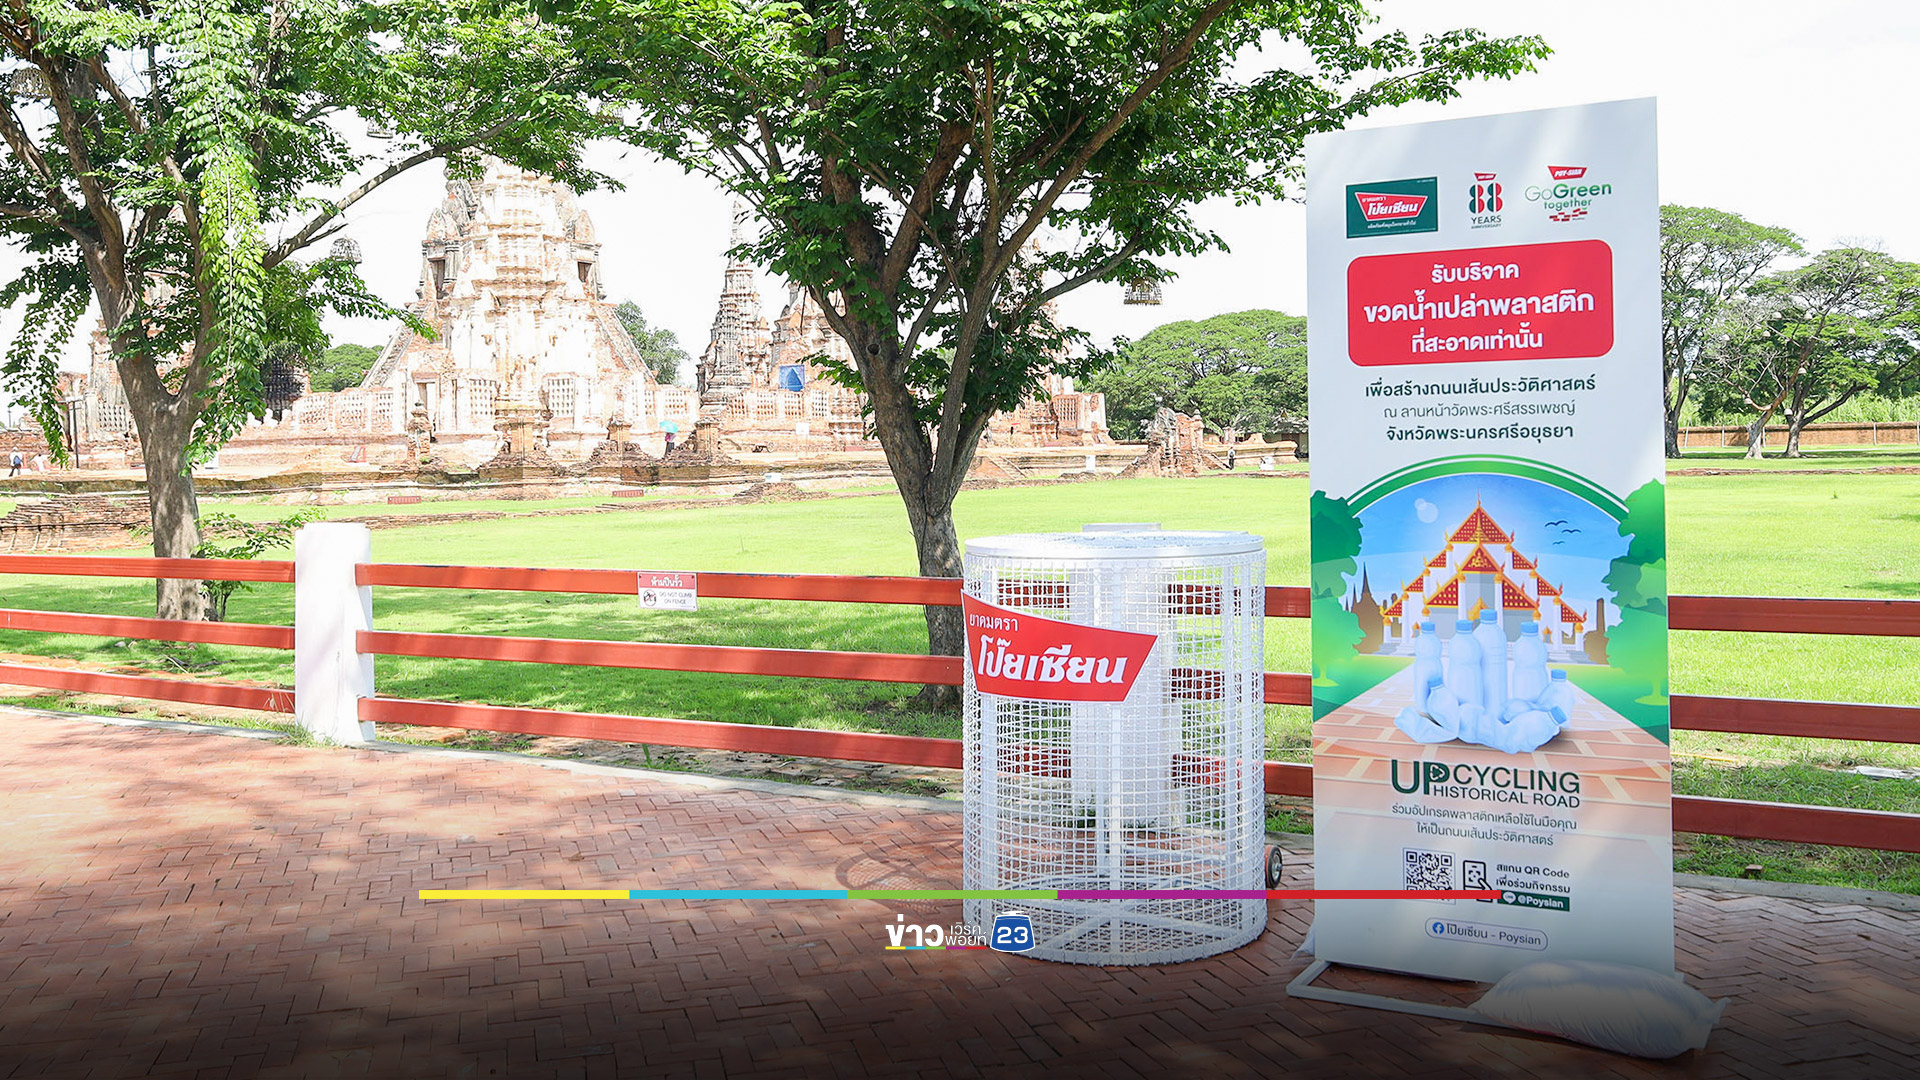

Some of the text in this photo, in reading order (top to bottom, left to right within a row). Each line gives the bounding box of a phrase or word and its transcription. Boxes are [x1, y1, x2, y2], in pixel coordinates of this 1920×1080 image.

[1544, 198, 1592, 211] together
[1471, 214, 1502, 224] YEARS
[1431, 261, 1520, 284] รับบริจาค
[1363, 288, 1595, 323] ขวดน้ำเปล่าพลาสติก
[1410, 322, 1543, 353] ที่สะอาดเท่านั้น
[1365, 373, 1596, 397] เพื่อสร้างถนนเส้นประวัติศาสตร์
[1383, 399, 1576, 419] ณ ลานหน้าวัดพระศรีสรรเพชญ์
[1386, 422, 1574, 443] จังหวัดพระนครศรีอยุธยา
[969, 613, 1019, 632] ยาดมตรา
[977, 633, 1128, 684] โป๊ยเซียน
[1434, 787, 1580, 809] HISTORICAL ROAD
[1496, 863, 1570, 879] สแกน QR Code
[1496, 874, 1571, 894] เพื่อร่วมกิจกรรม
[1517, 893, 1564, 909] @Poysian
[1499, 930, 1542, 946] Poysian
